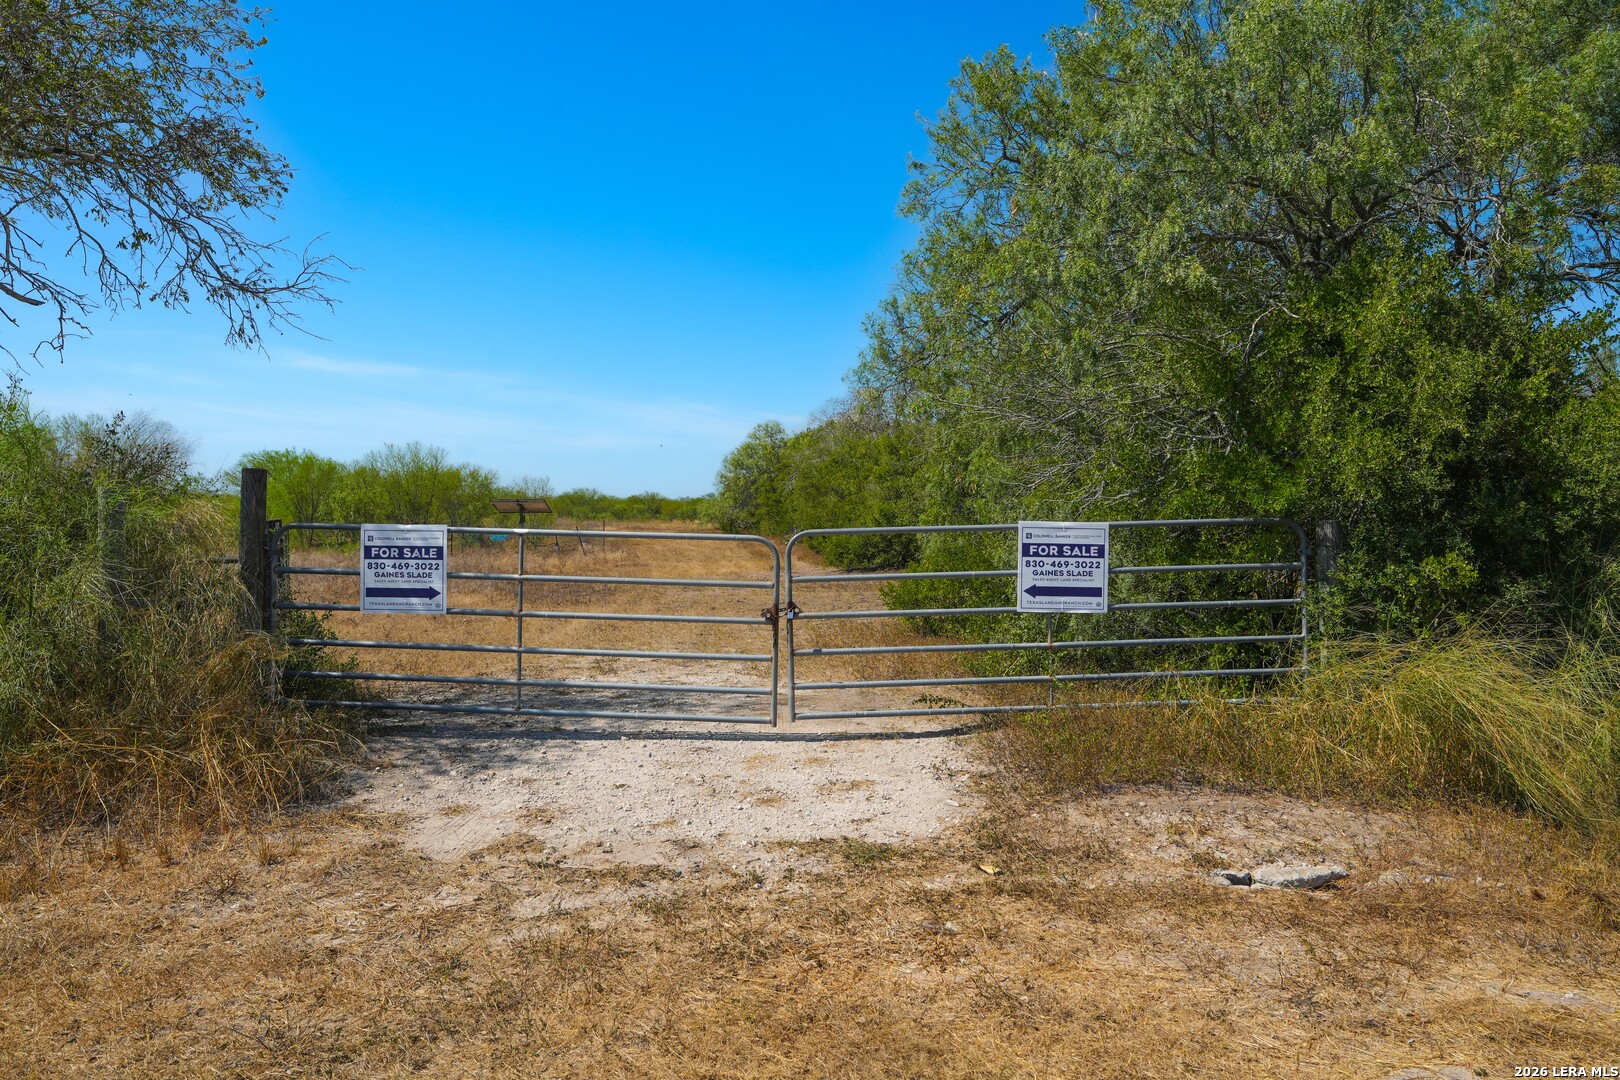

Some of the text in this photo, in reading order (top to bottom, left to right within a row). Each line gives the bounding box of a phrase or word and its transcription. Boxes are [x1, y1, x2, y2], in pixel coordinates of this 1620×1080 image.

[372, 547, 437, 558] FOR SALE
[1030, 545, 1098, 556] FOR SALE
[367, 562, 440, 570] 830-469-3022
[1025, 560, 1100, 568] 830-469-3022
